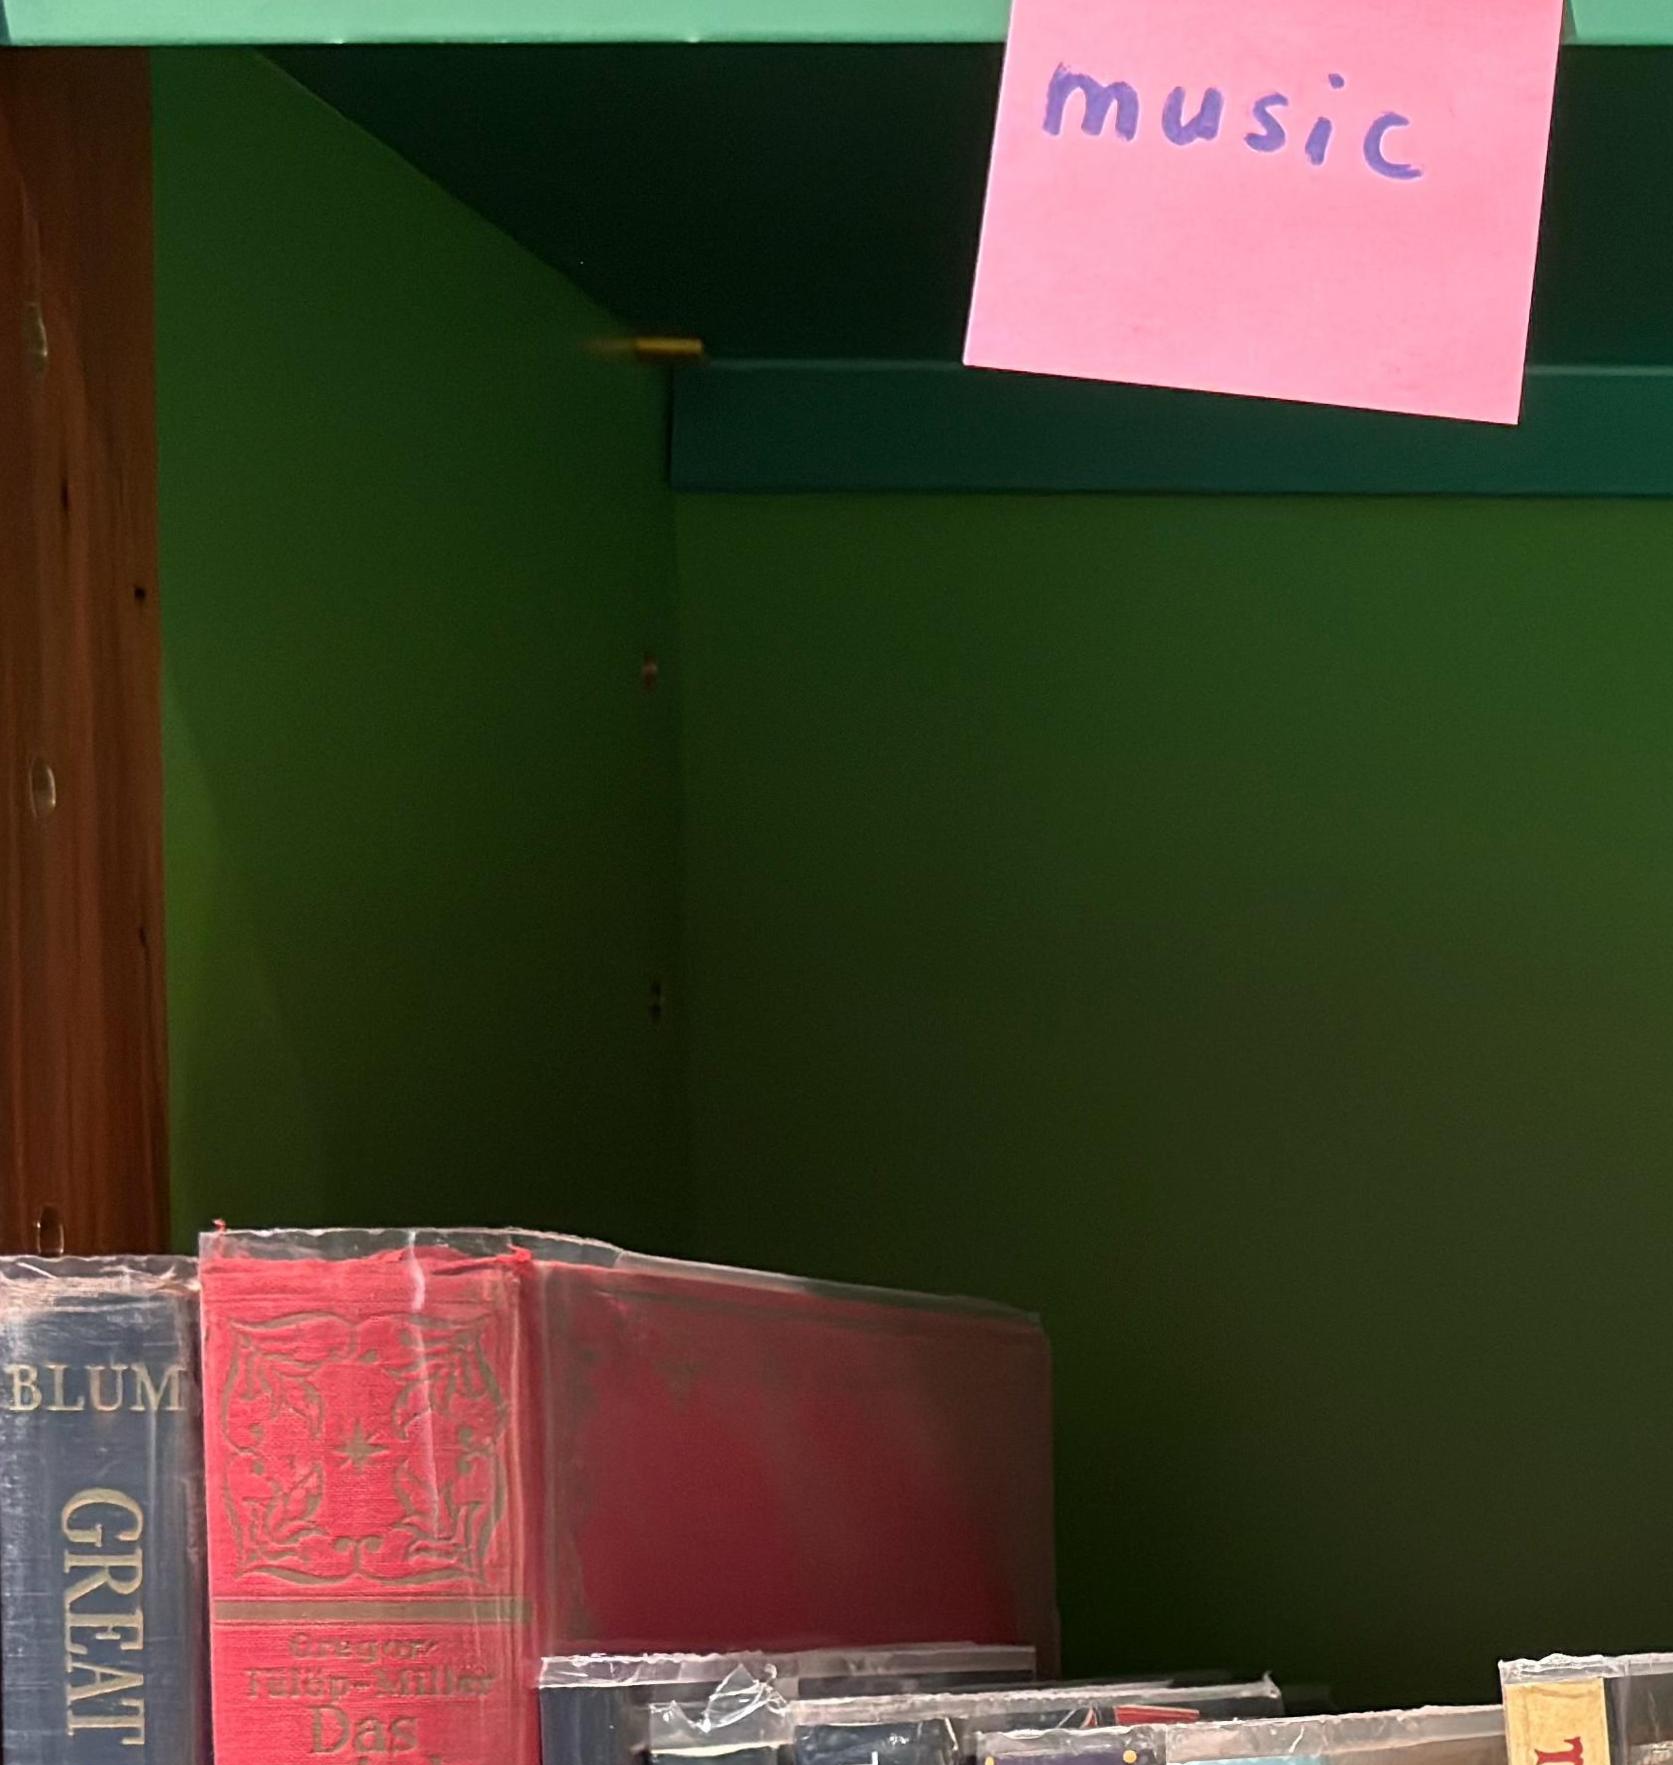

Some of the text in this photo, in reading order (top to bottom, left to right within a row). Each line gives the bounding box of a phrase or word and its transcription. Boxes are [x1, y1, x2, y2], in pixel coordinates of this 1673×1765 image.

[1042, 61, 1424, 179] music
[6, 1364, 188, 1412] BLUM
[61, 1488, 145, 1745] GREAT
[308, 1704, 419, 1754] Das
